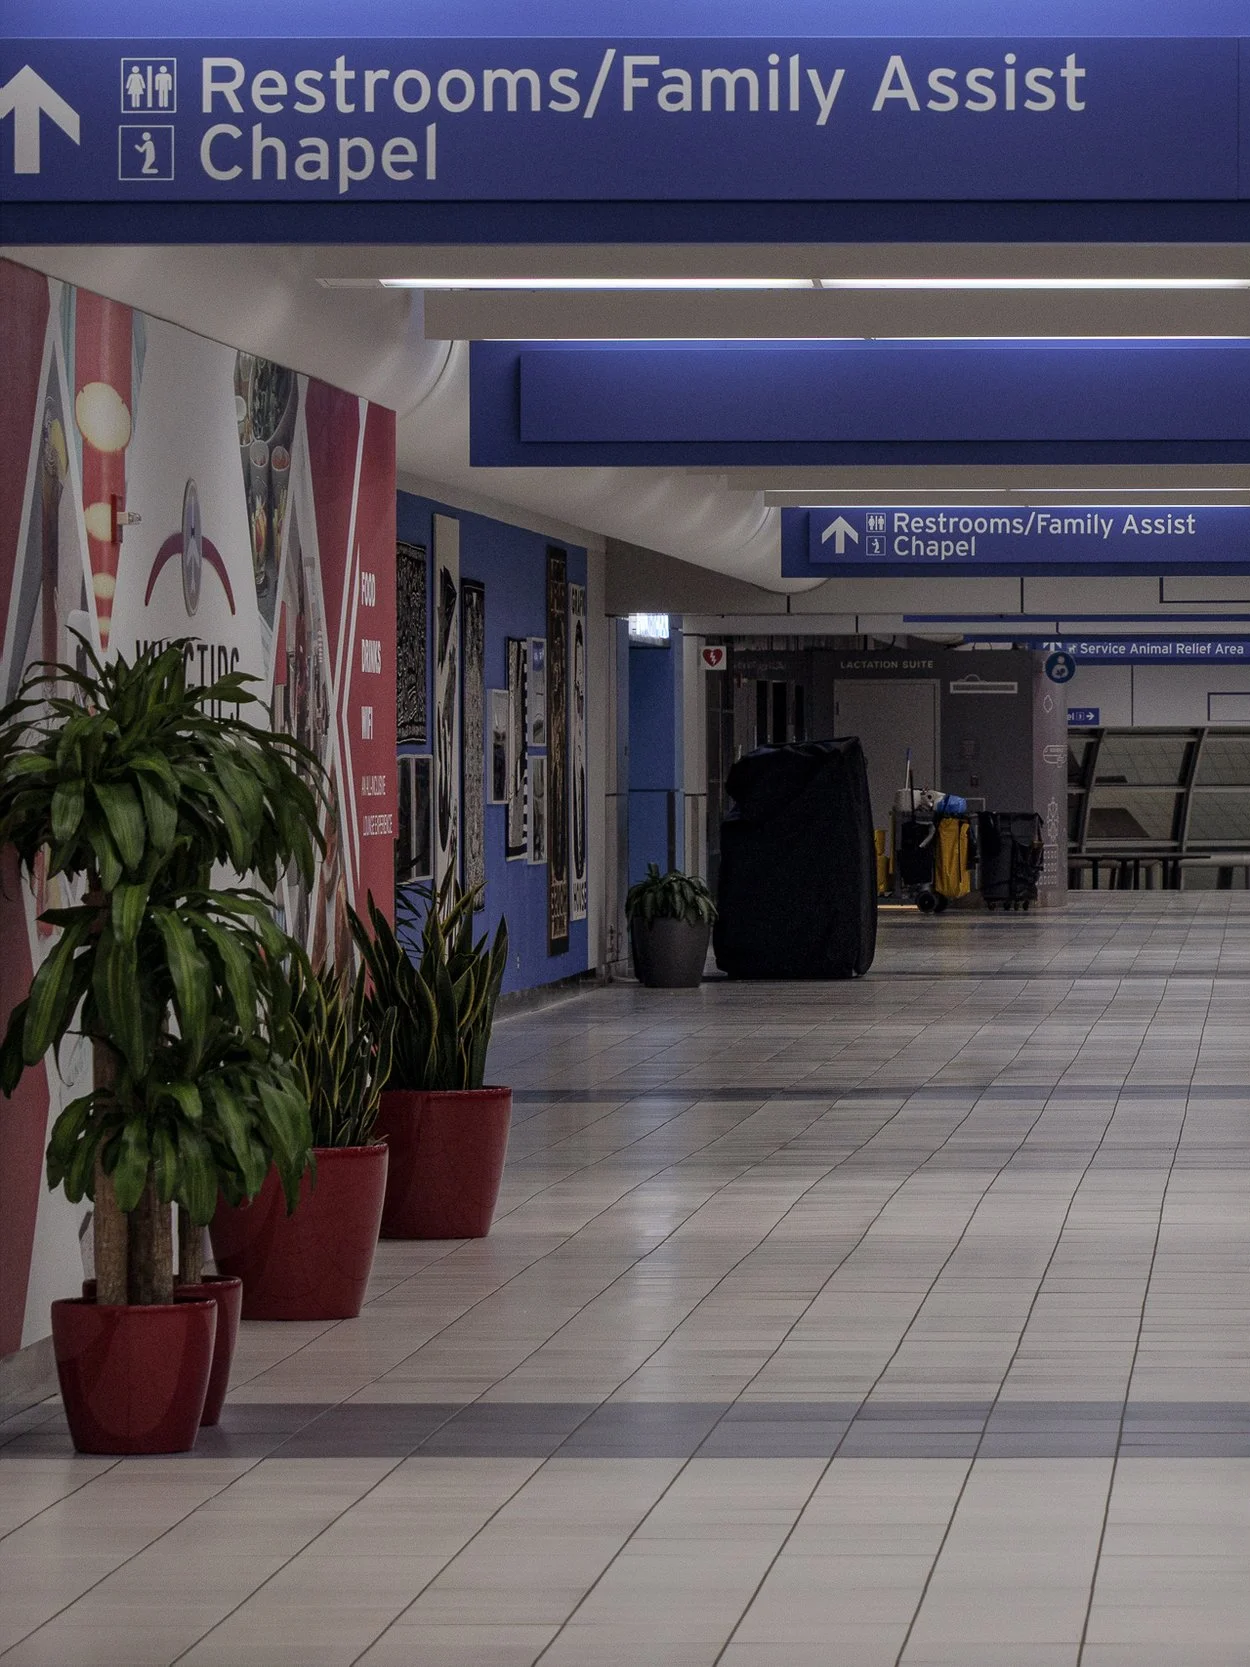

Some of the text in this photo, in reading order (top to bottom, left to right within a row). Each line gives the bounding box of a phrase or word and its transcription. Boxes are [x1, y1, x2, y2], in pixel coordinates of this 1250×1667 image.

[202, 48, 1086, 126] Restrooms/Family Assist
[200, 122, 437, 196] Chapel
[893, 511, 1196, 539] Restrooms/Family Assist
[893, 535, 976, 561] Chapel
[361, 571, 376, 607] FOOD
[361, 638, 382, 674] DRINKS
[1079, 641, 1245, 655] Service Animal Relief Area
[840, 660, 934, 669] LACTATION SUITE
